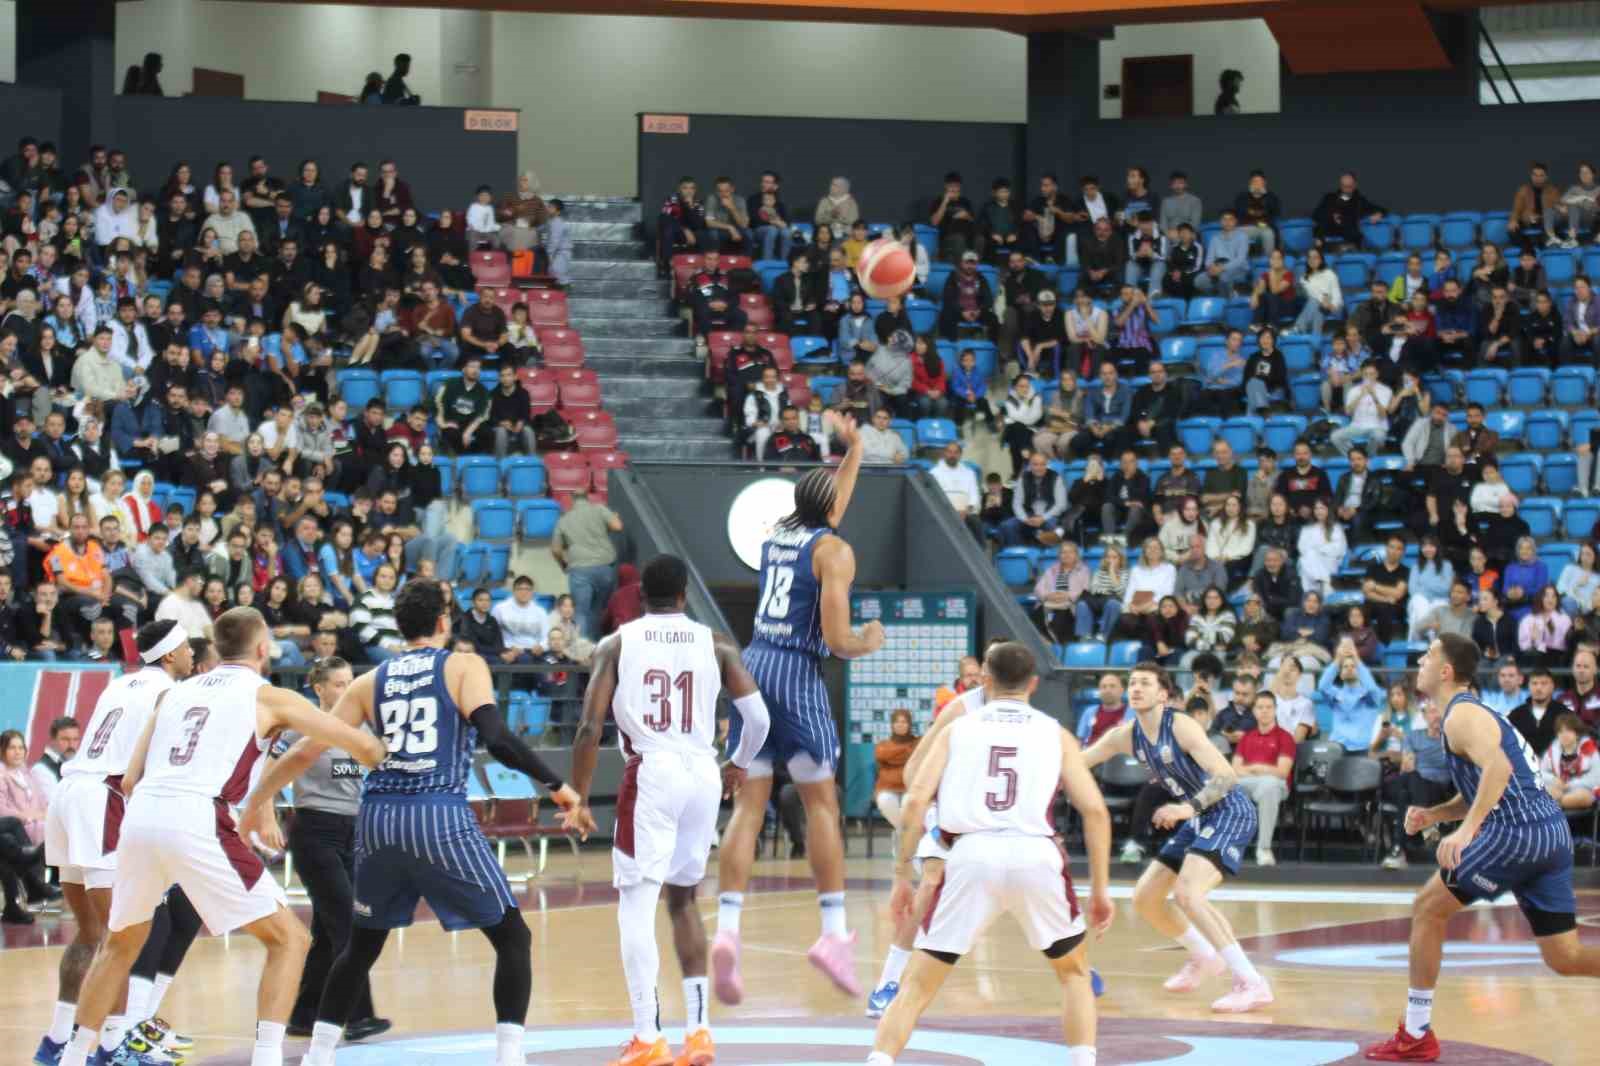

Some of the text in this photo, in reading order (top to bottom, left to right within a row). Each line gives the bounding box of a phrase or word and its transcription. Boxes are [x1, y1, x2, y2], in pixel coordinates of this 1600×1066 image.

[758, 565, 794, 619] 13
[644, 630, 695, 644] DELGADO
[643, 668, 694, 734] 31
[87, 706, 123, 760] 0
[169, 706, 210, 766] 3
[985, 745, 1018, 812] 5
